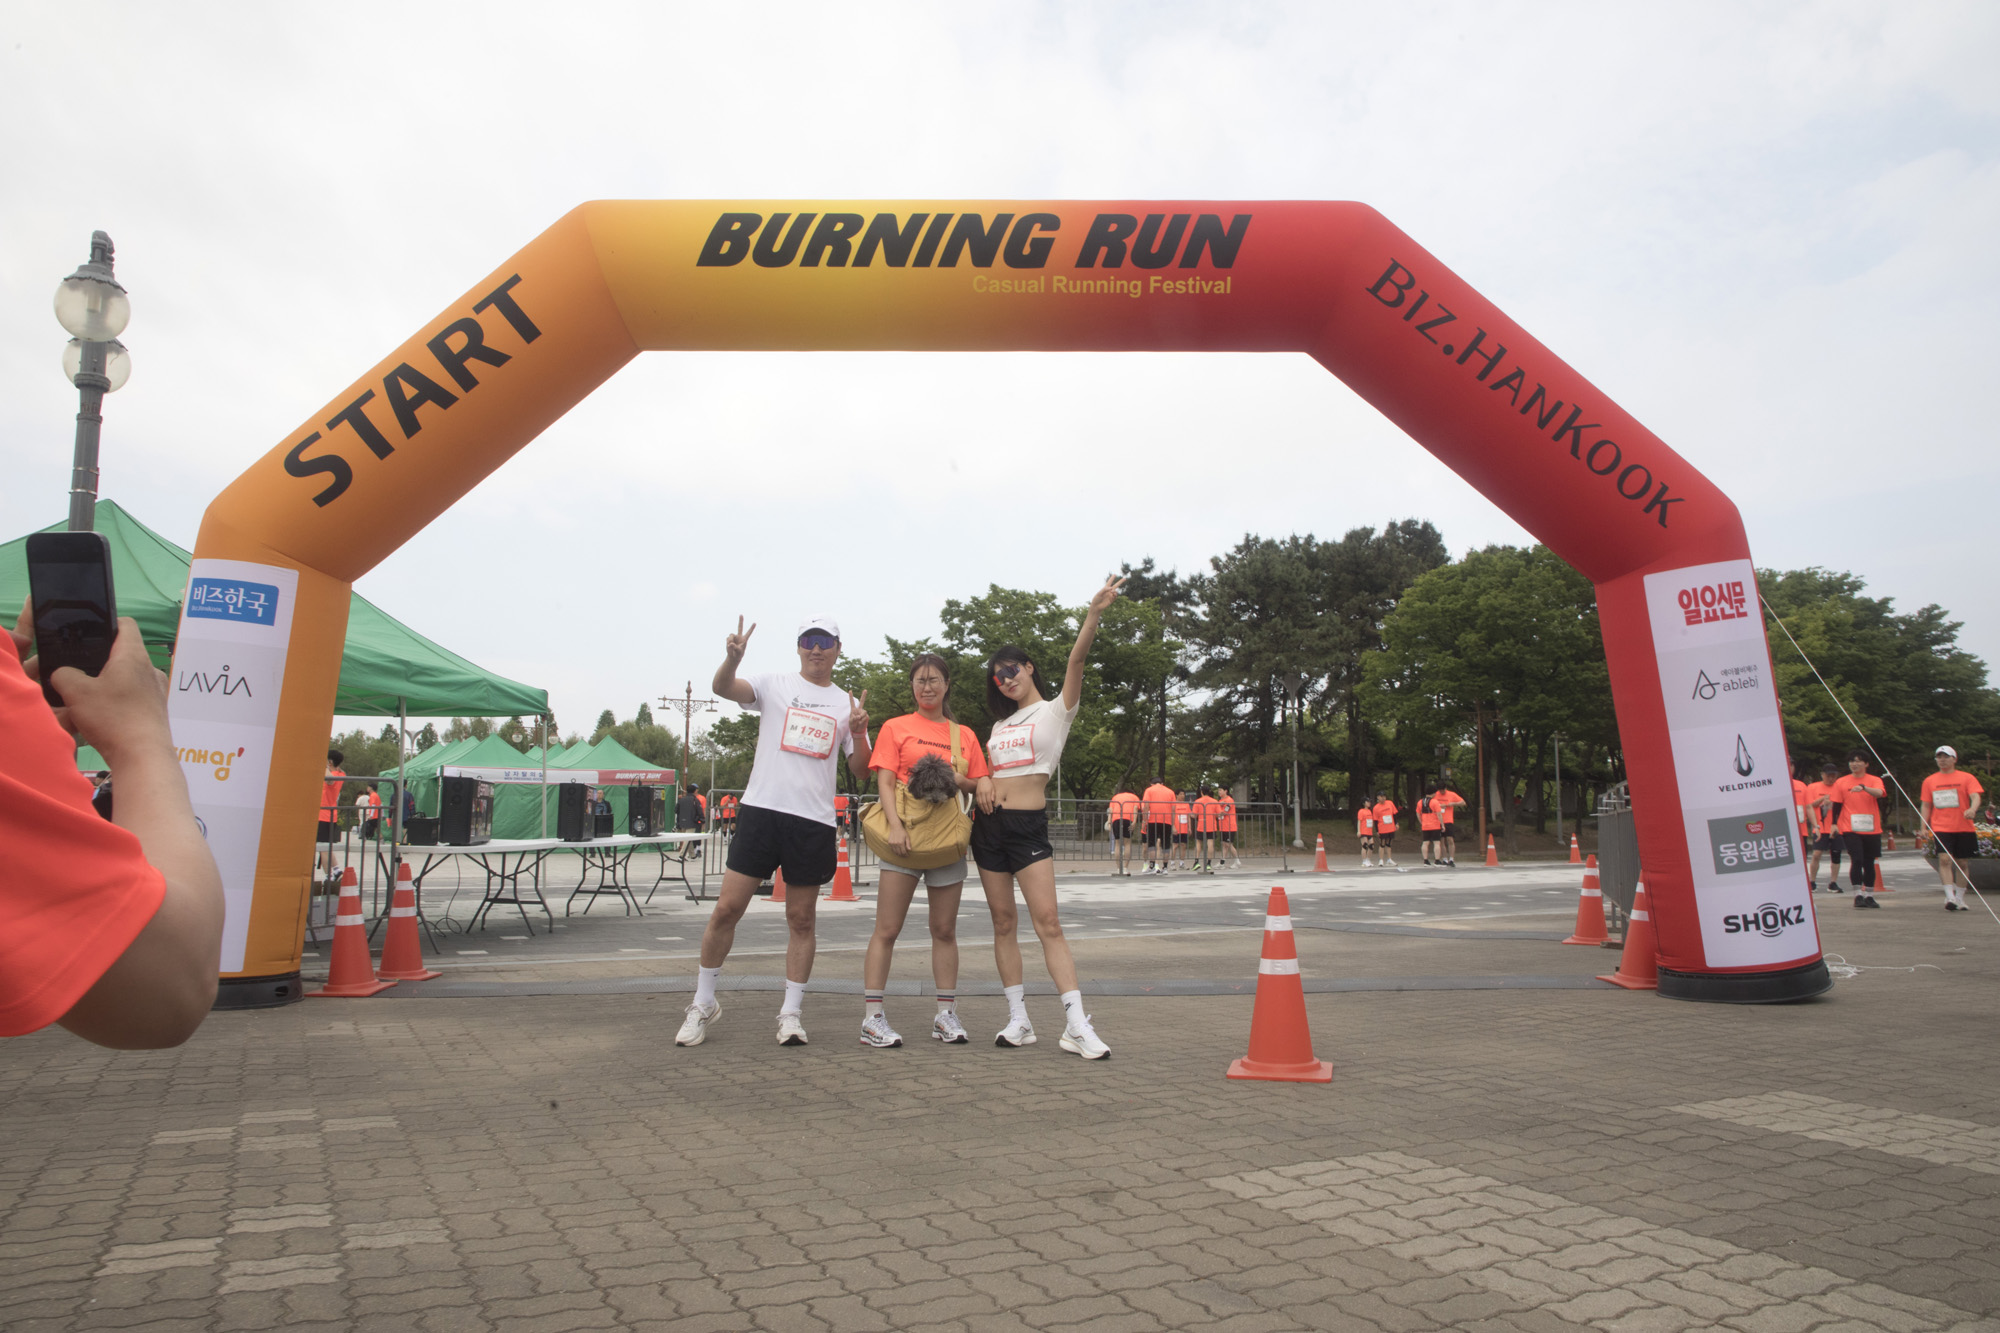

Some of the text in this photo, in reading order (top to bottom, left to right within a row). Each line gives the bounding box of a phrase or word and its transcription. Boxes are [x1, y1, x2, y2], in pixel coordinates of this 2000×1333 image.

[695, 212, 1253, 269] BURNING RUN
[972, 275, 1232, 298] Casual Running Festival
[284, 273, 543, 509] START
[193, 584, 269, 618] 비즈한국
[1677, 581, 1748, 626] 일요신문
[1722, 675, 1759, 692] ablebj
[801, 725, 830, 741] 1782
[998, 737, 1026, 751] 3183
[1718, 778, 1773, 793] VELOTHORN
[1719, 835, 1790, 867] 동원샘물
[1723, 904, 1805, 934] SHOKZ
